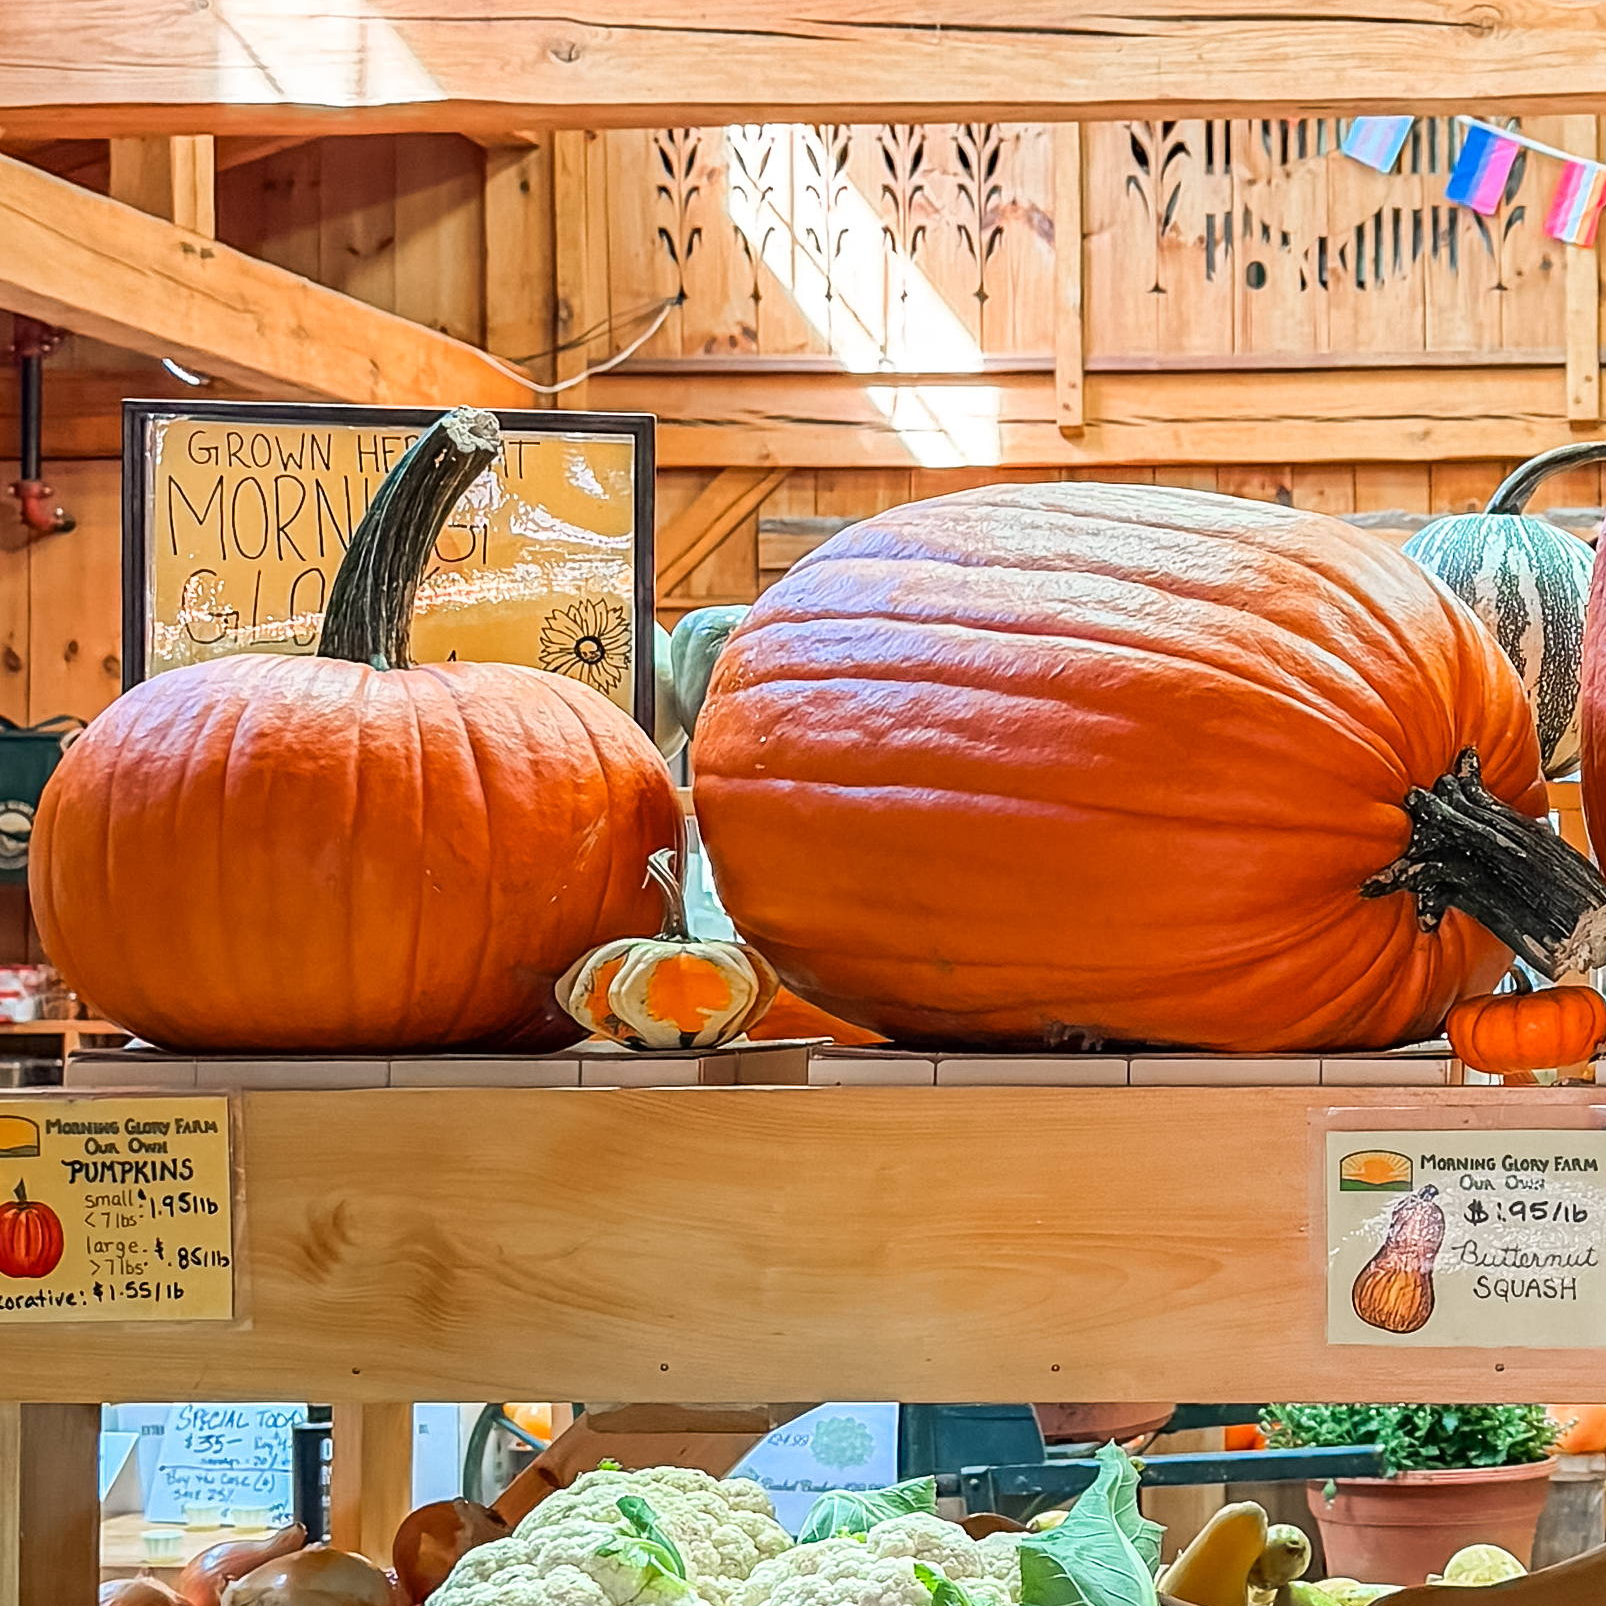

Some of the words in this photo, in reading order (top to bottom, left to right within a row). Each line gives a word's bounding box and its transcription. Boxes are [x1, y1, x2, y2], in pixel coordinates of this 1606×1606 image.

[187, 429, 333, 472] GROWN
[358, 433, 417, 474] HE
[46, 1118, 120, 1135] MORNING
[124, 1118, 170, 1136] GLORY
[175, 1118, 218, 1134] FARM
[84, 1137, 120, 1155] OUR
[128, 1137, 168, 1154] OWN
[61, 1158, 194, 1184] PUMPKINS
[1420, 1154, 1496, 1172] MORNING
[1502, 1154, 1549, 1173] GLORY
[1554, 1155, 1598, 1172] FARM
[1459, 1174, 1496, 1191] OUR
[1451, 1239, 1599, 1269] Butternut
[1473, 1276, 1577, 1303] SQUASH
